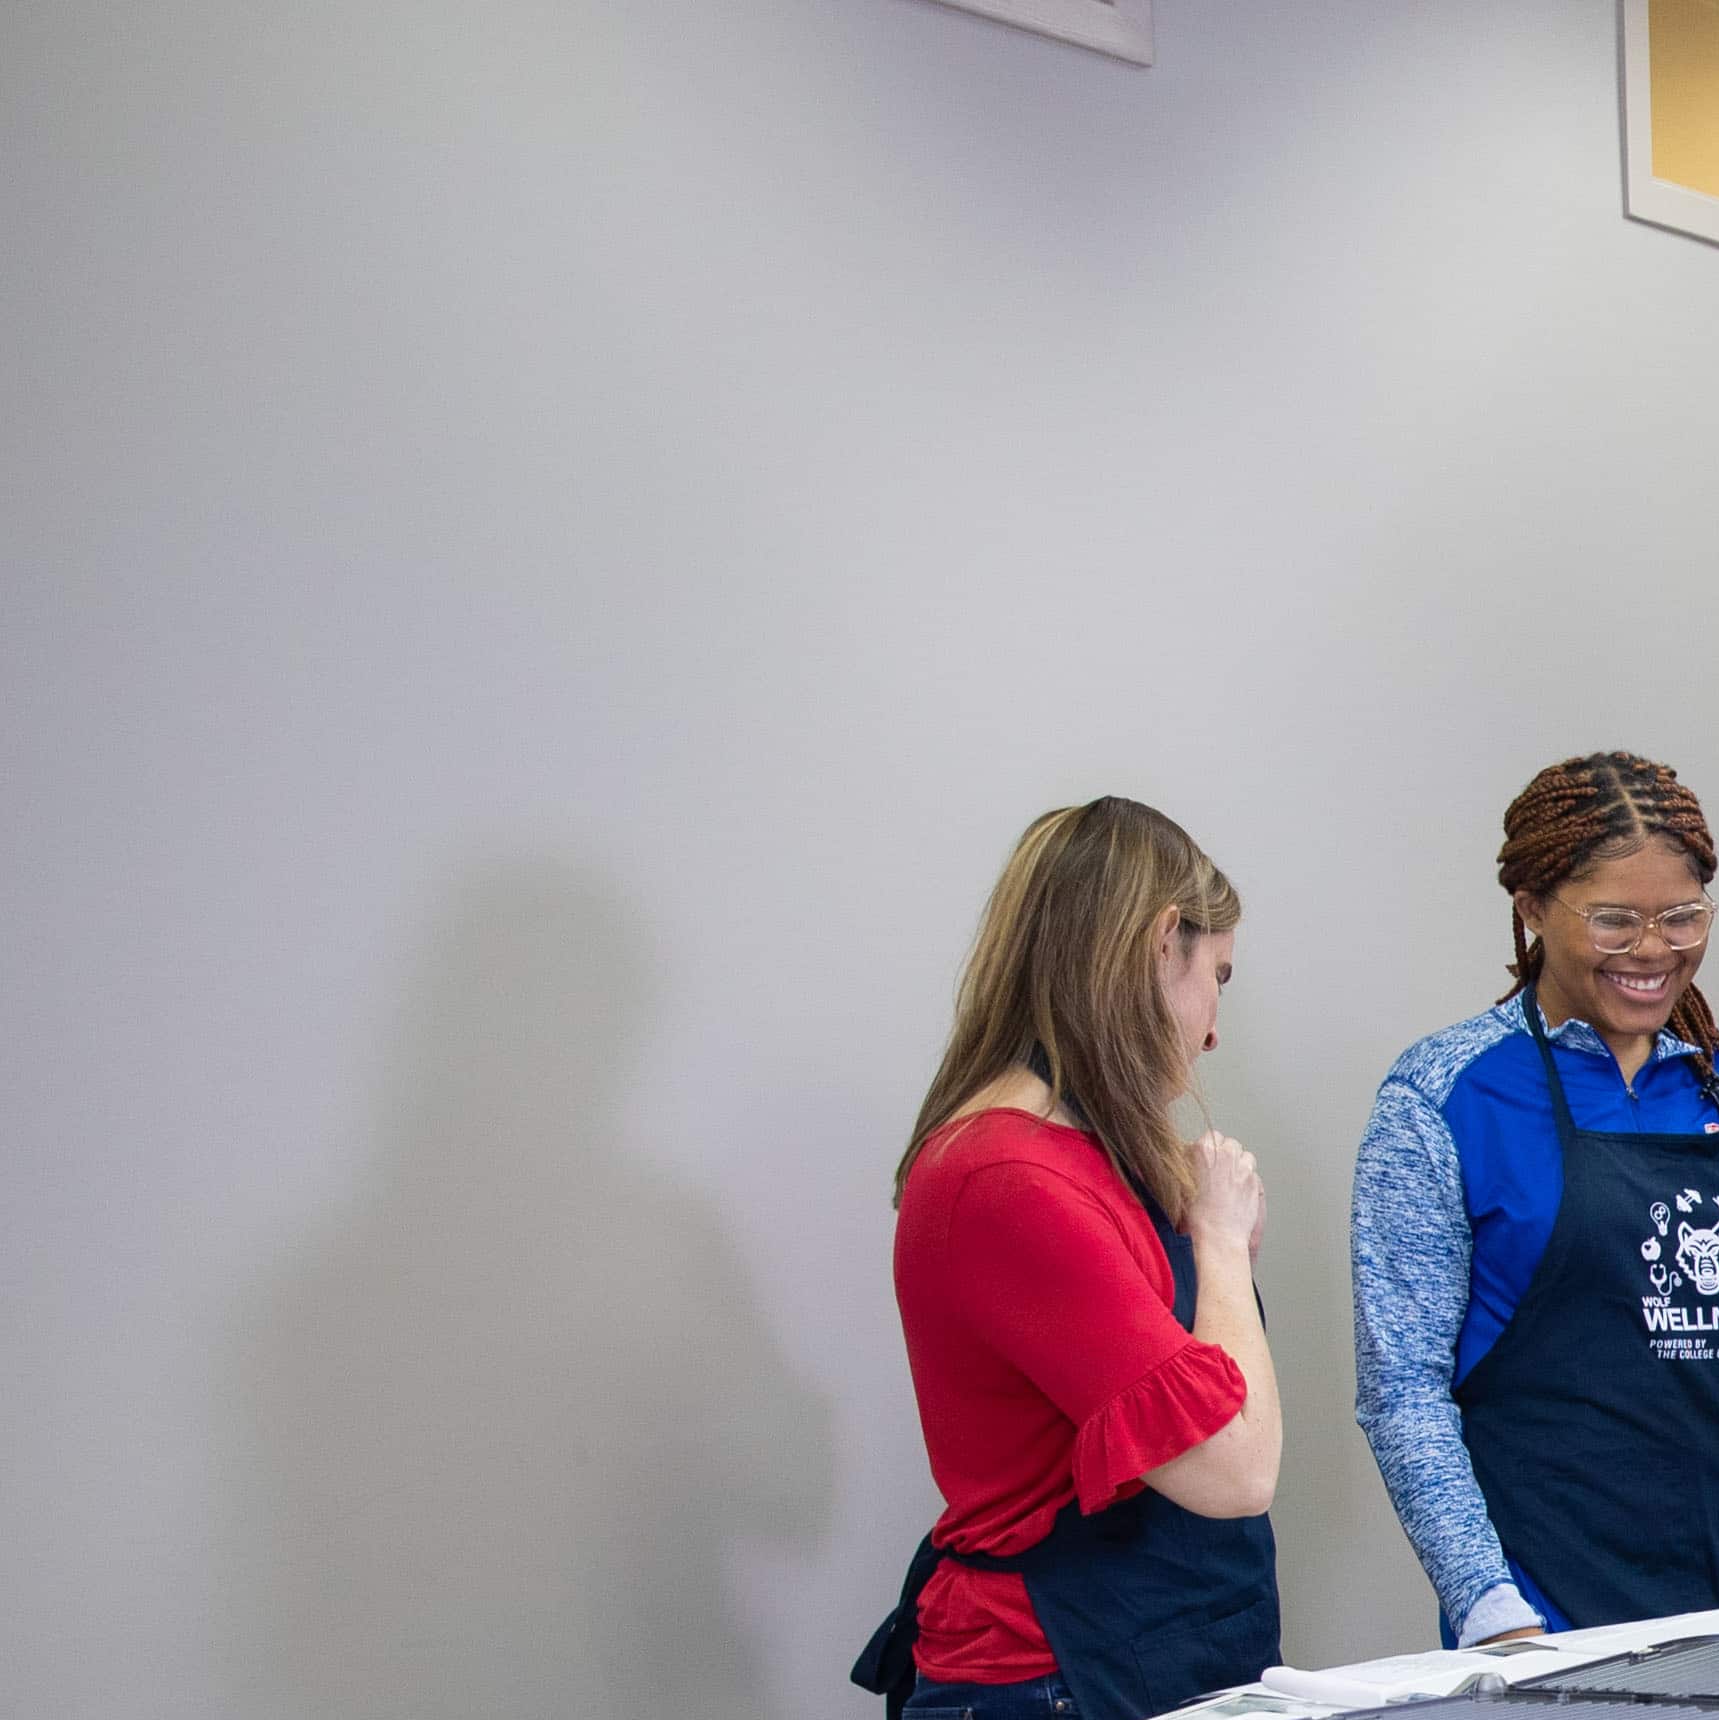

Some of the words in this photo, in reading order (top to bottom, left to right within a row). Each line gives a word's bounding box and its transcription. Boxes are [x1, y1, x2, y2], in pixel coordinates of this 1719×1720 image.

[1642, 1296, 1671, 1307] WOLF
[1649, 1339, 1692, 1349] POWERED
[1695, 1339, 1707, 1349] BY
[1657, 1350, 1676, 1359] THE
[1679, 1348, 1714, 1359] COLLEGE
